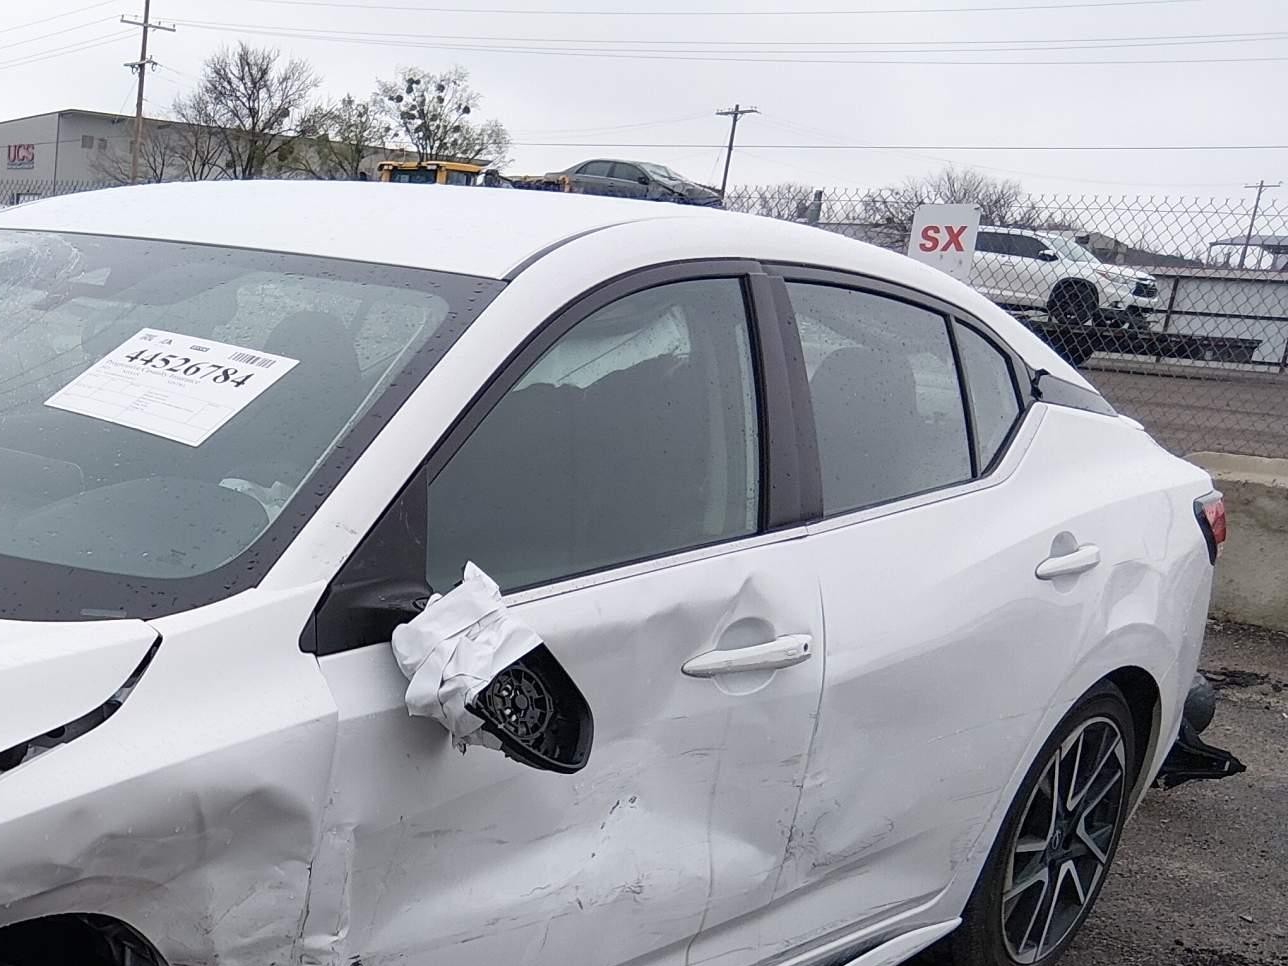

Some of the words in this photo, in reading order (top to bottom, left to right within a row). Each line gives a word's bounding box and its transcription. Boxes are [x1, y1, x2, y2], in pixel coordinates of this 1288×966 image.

[8, 144, 35, 162] UCS
[919, 225, 968, 252] SX
[125, 349, 255, 388] 44526784
